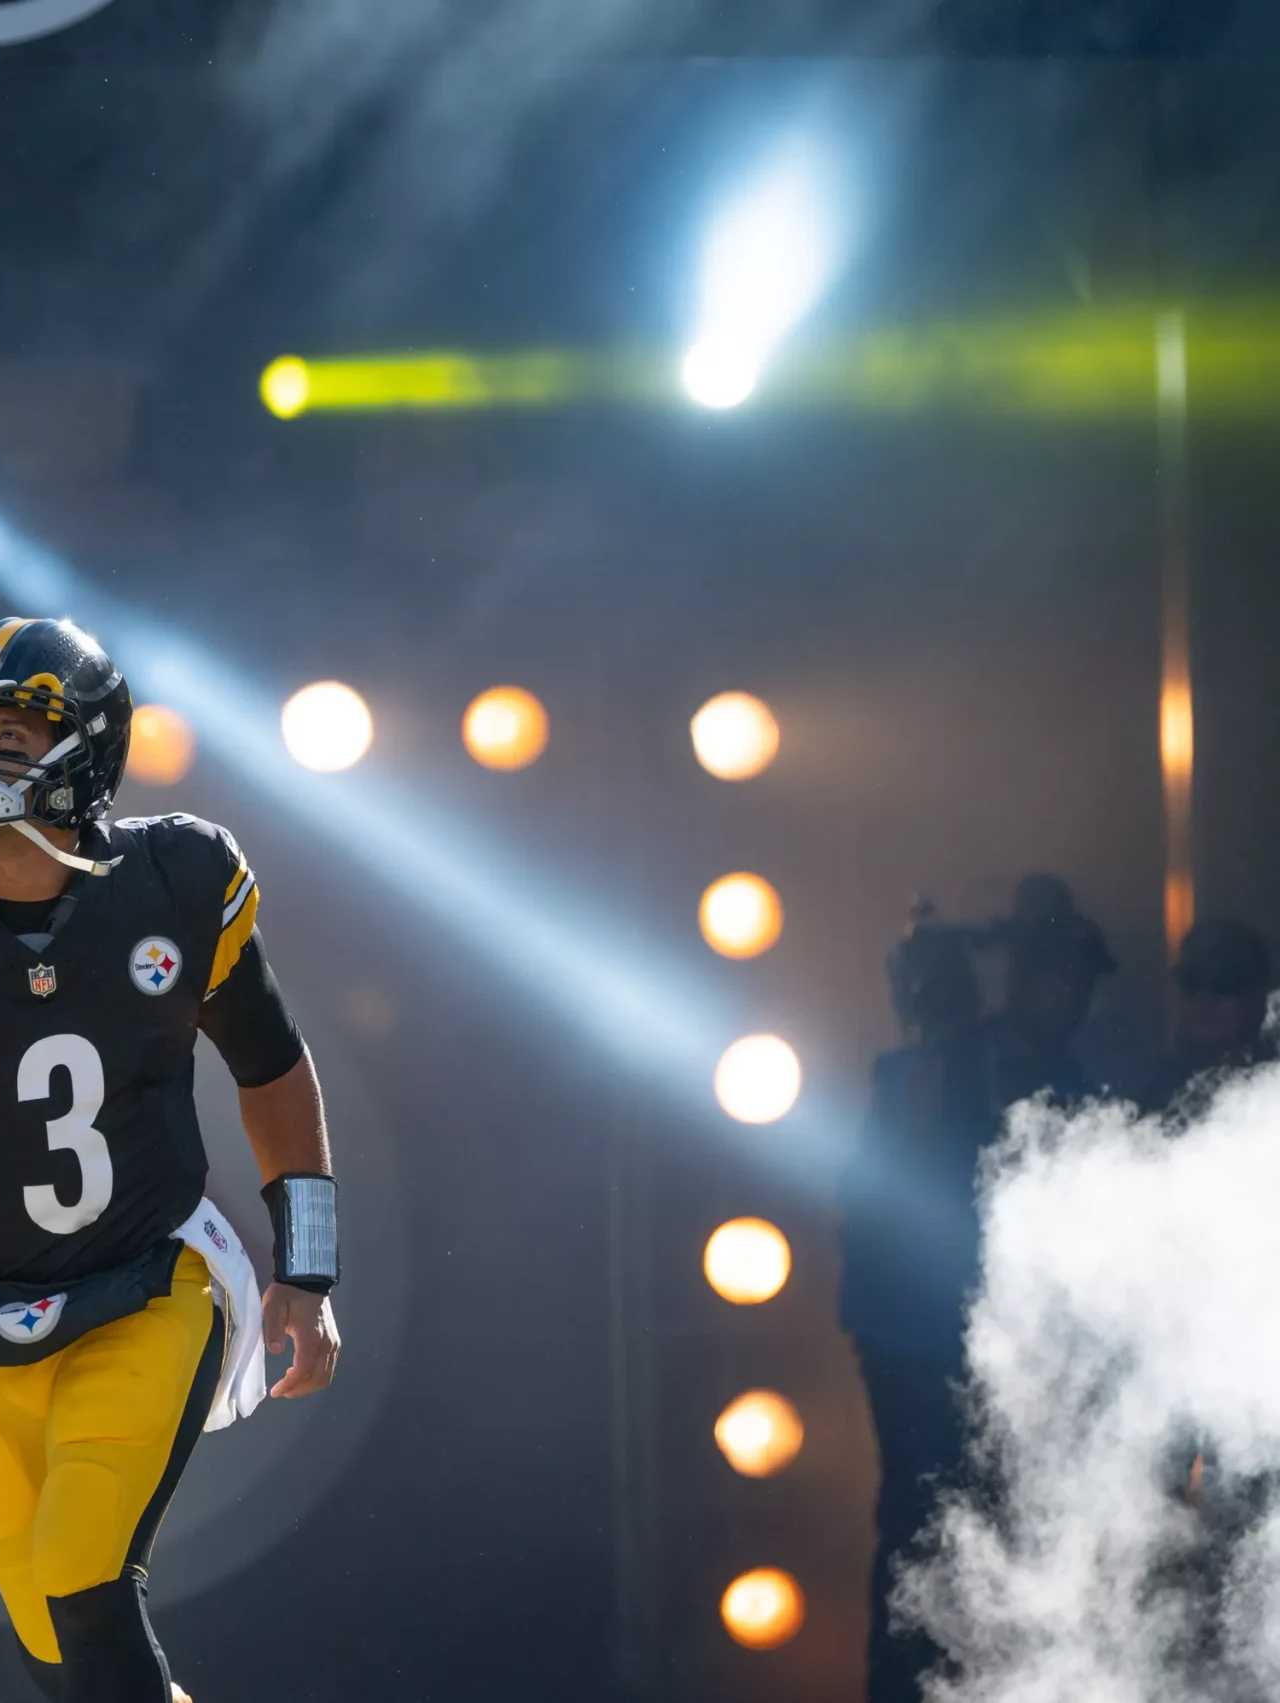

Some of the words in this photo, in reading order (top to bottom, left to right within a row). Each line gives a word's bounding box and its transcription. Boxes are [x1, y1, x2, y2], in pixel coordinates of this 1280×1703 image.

[134, 962, 156, 971] Steelers
[34, 978, 53, 991] NFL
[17, 1033, 114, 1235] 3
